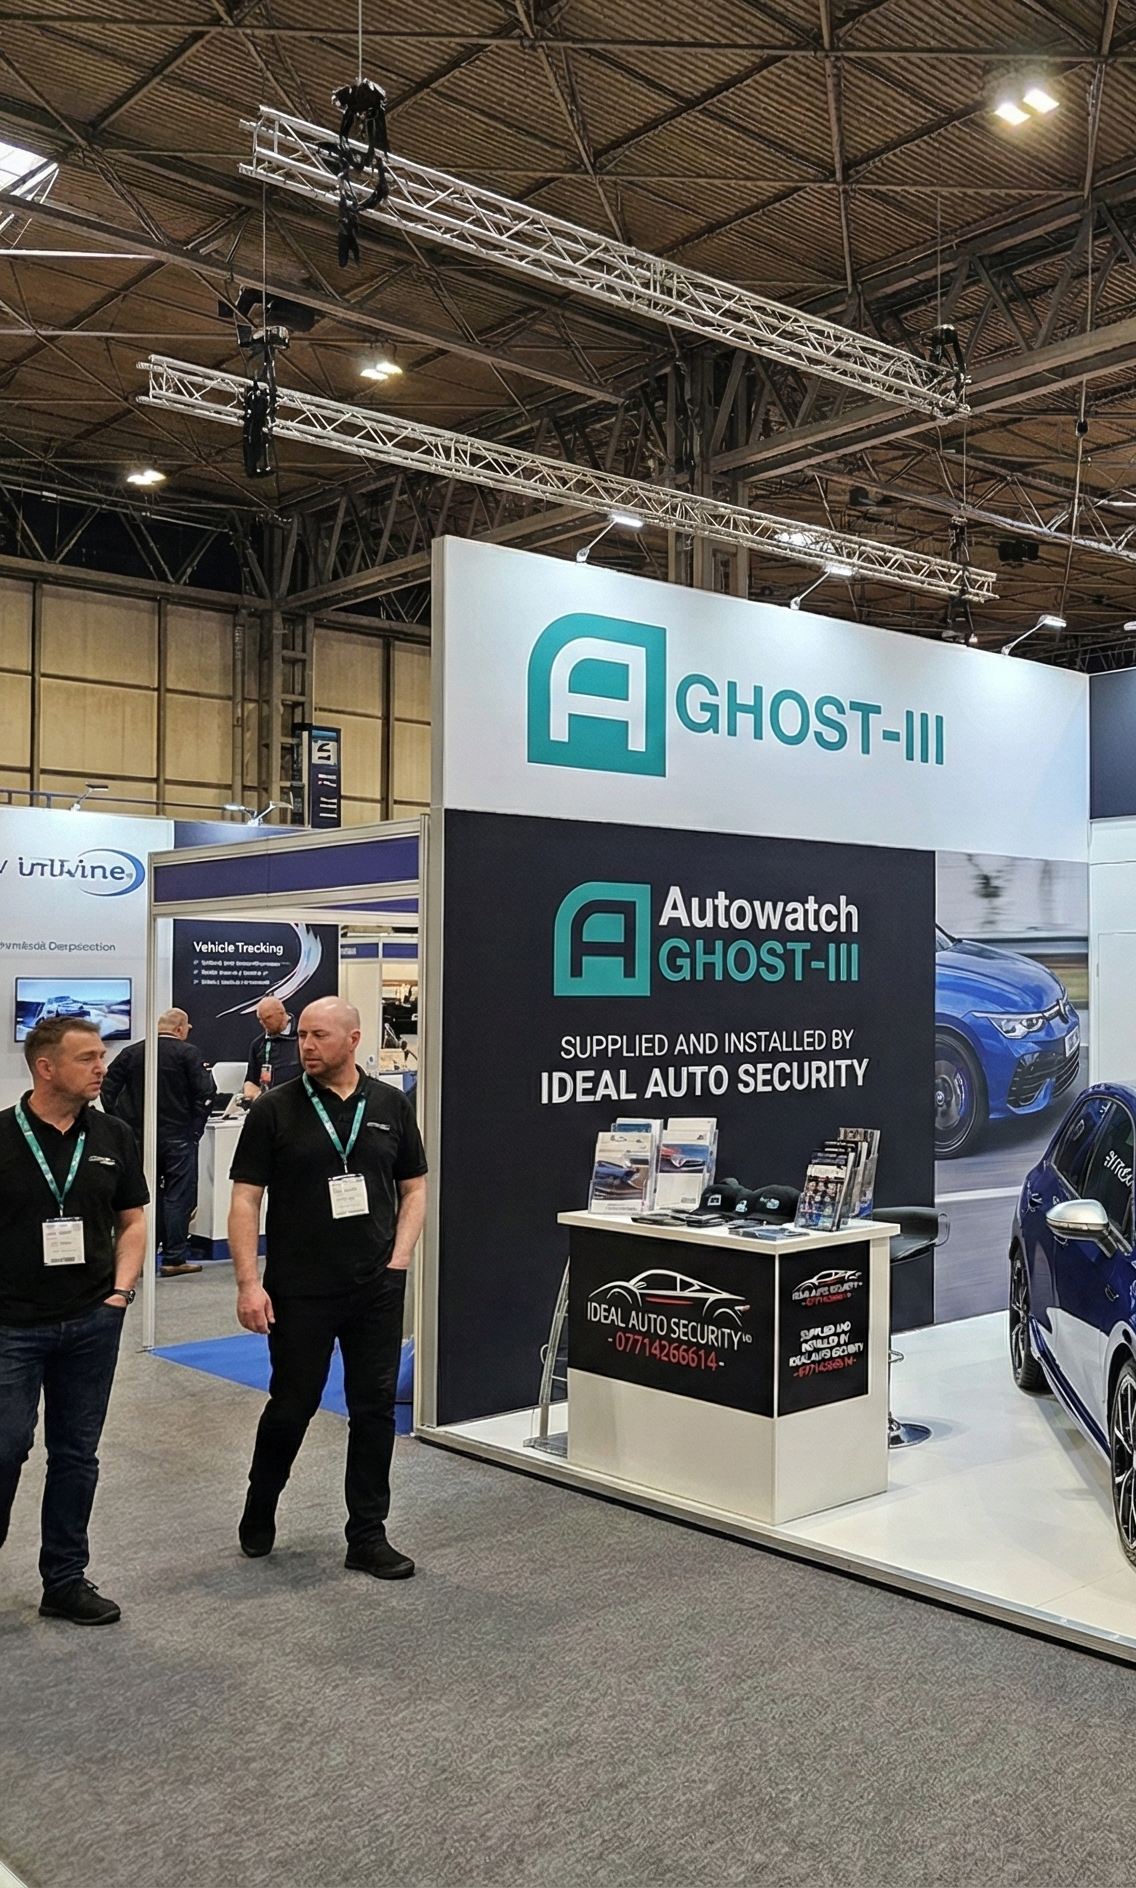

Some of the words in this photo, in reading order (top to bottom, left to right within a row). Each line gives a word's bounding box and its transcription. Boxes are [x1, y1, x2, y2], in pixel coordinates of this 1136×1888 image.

[675, 673, 944, 767] GHOST-III
[658, 886, 859, 933] Autowatch
[193, 941, 235, 954] Vehicle
[658, 937, 859, 982] GHOST-III
[560, 1034, 669, 1059] SUPPLIED
[674, 1032, 719, 1055] AND
[724, 1030, 827, 1054] INSTALLED
[831, 1029, 854, 1050] BY
[541, 1069, 638, 1104] IDEAL
[644, 1065, 729, 1099] AUTO
[737, 1058, 869, 1094] SECURITY
[587, 1301, 626, 1328] IDEAL
[628, 1310, 668, 1337] AUTO
[670, 1318, 742, 1351] SECURITY
